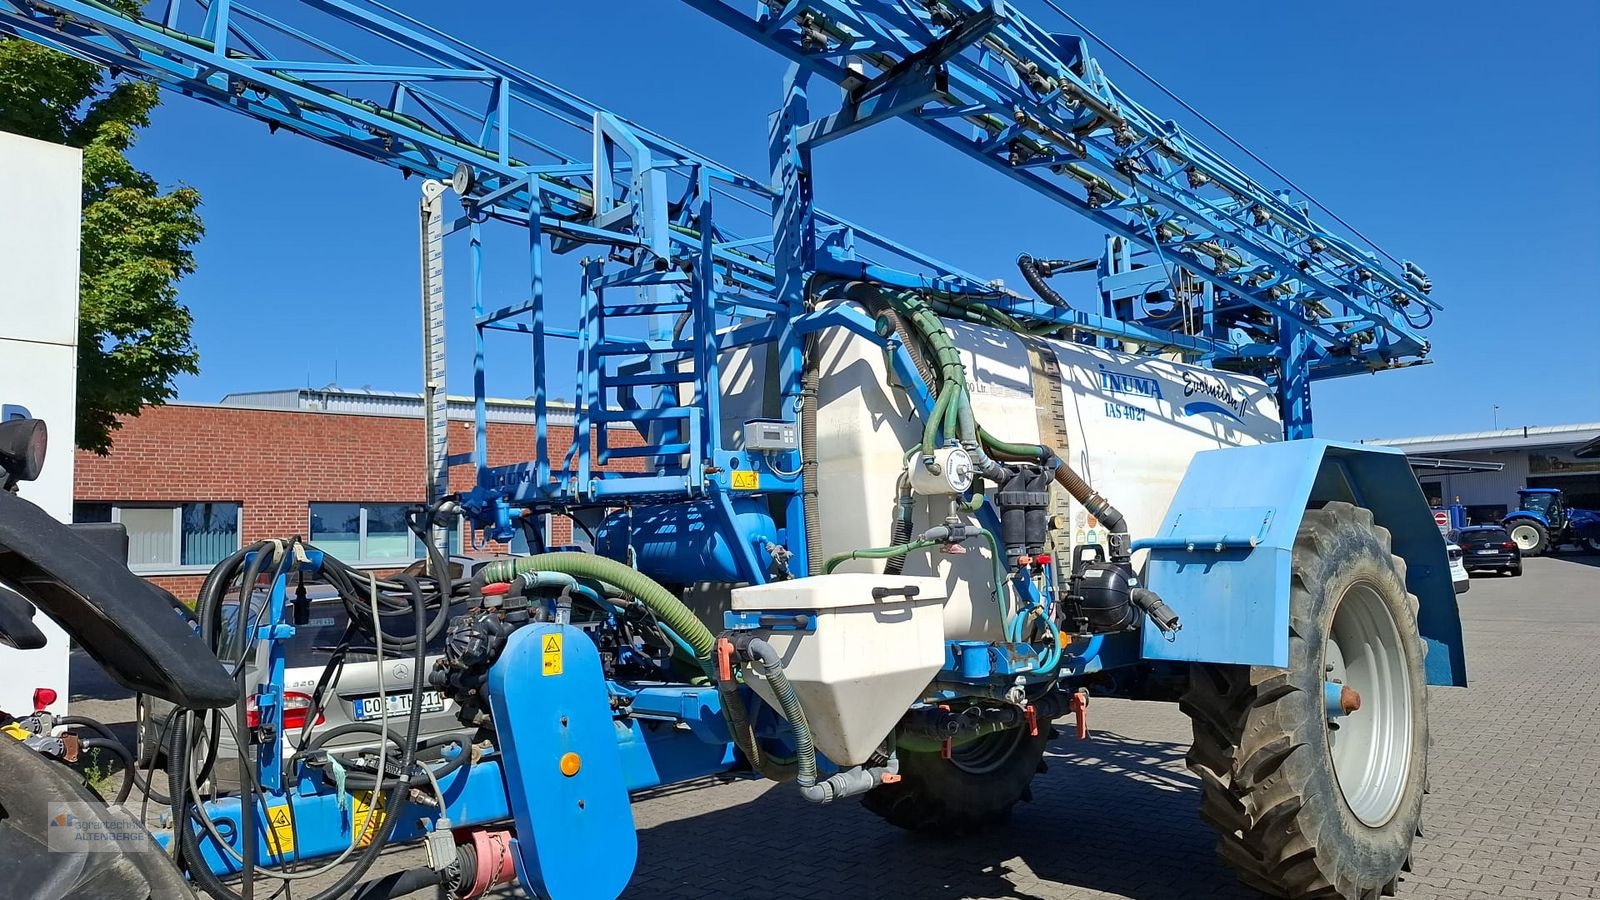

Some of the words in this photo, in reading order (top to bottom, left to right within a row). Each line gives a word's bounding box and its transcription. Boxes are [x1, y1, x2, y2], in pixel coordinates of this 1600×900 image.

[1099, 364, 1164, 400] INUMA
[1182, 371, 1239, 411] Evolution
[1104, 402, 1122, 419] IAS
[1123, 405, 1146, 422] 4027
